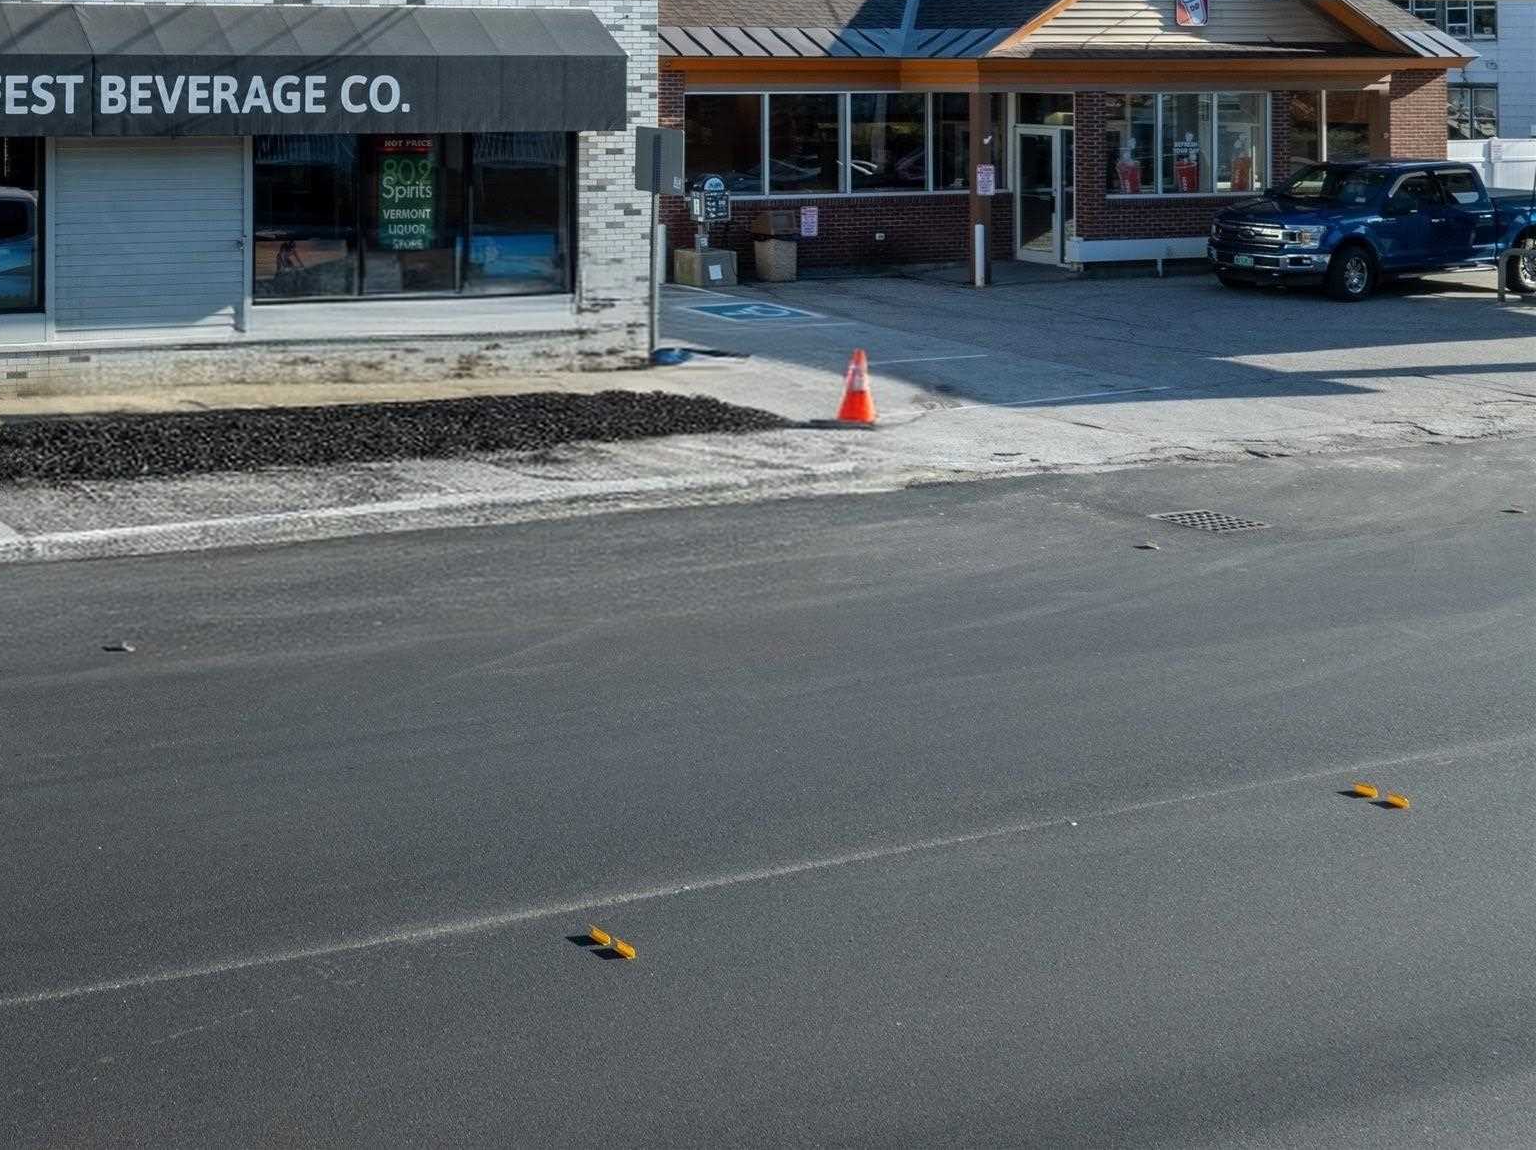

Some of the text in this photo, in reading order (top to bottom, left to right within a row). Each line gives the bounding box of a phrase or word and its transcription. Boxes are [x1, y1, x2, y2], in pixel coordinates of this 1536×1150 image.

[100, 75, 327, 114] BEVERAGE
[340, 74, 410, 113] CO.
[383, 159, 432, 185] 802
[382, 176, 433, 203] Spirits
[383, 209, 431, 219] VERMONT
[388, 224, 426, 235] LIQUOR
